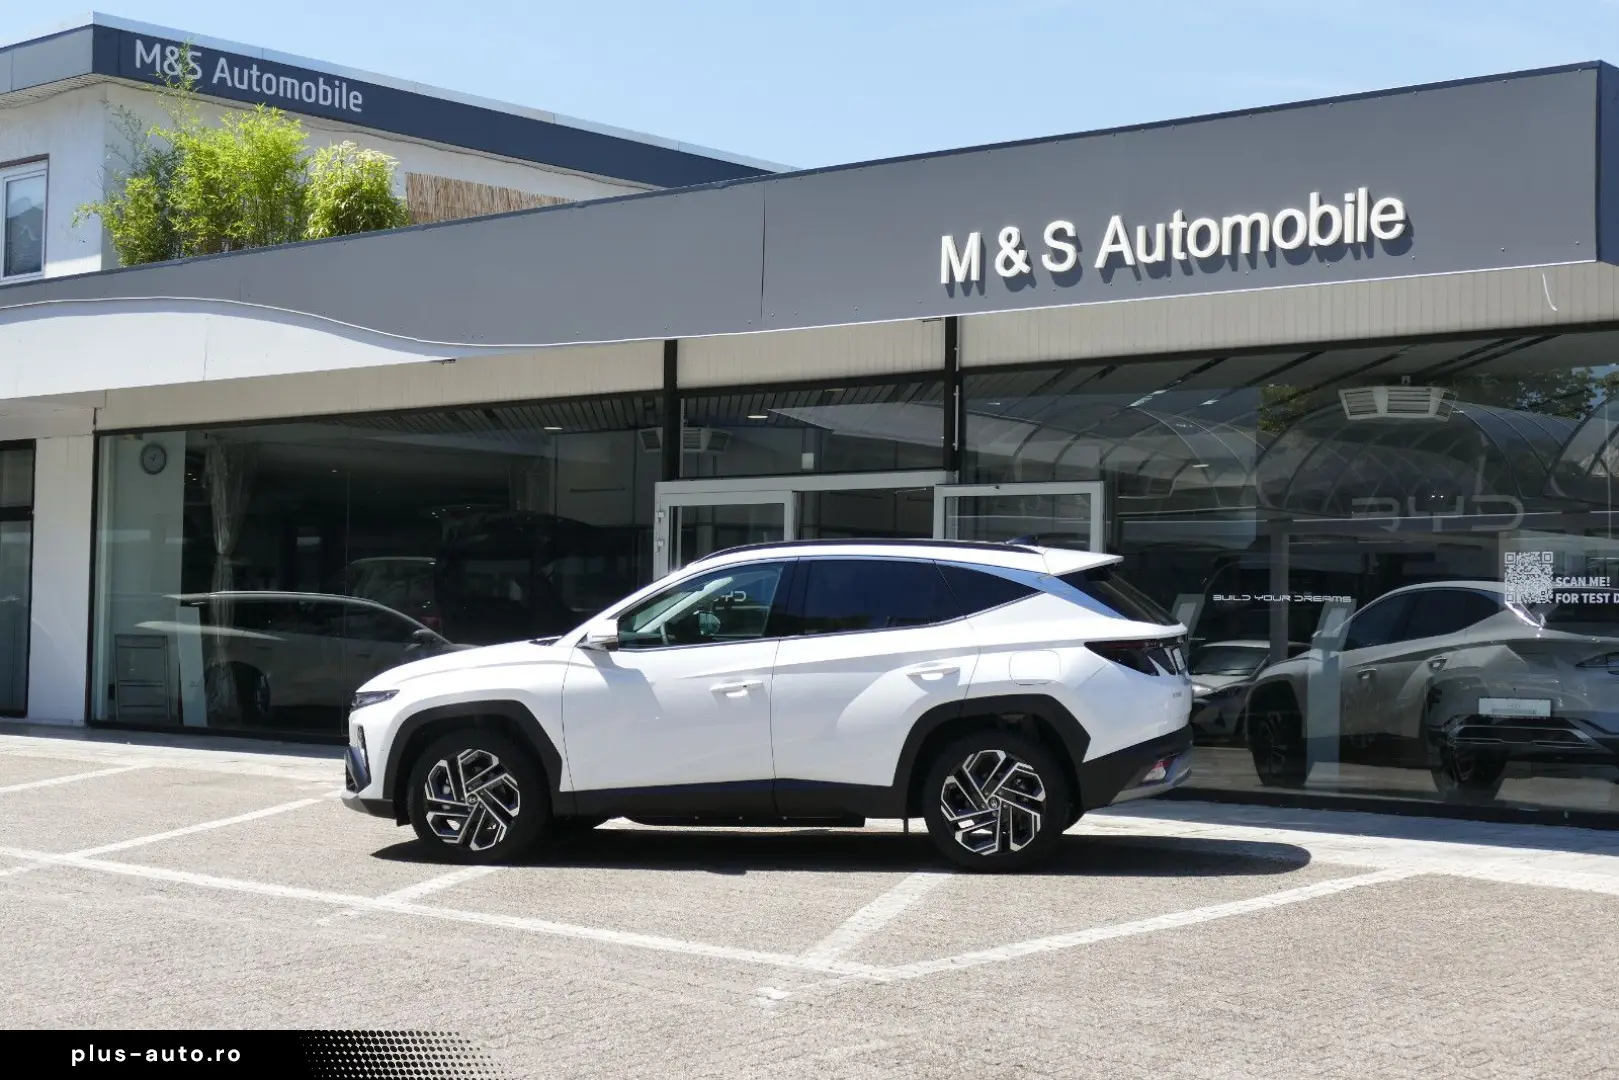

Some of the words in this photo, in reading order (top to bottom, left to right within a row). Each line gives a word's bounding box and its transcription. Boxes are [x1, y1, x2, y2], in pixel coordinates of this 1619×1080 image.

[135, 39, 202, 80] M&S
[212, 57, 363, 112] Automobile
[941, 232, 981, 284] M
[995, 226, 1030, 278] &
[1042, 220, 1077, 272] S
[1094, 187, 1406, 268] Automobile
[1555, 577, 1586, 587] SCAN
[1590, 577, 1611, 587] ME!
[1254, 594, 1291, 602] YOUR
[1555, 593, 1579, 604] FOR
[1581, 593, 1610, 604] TEST
